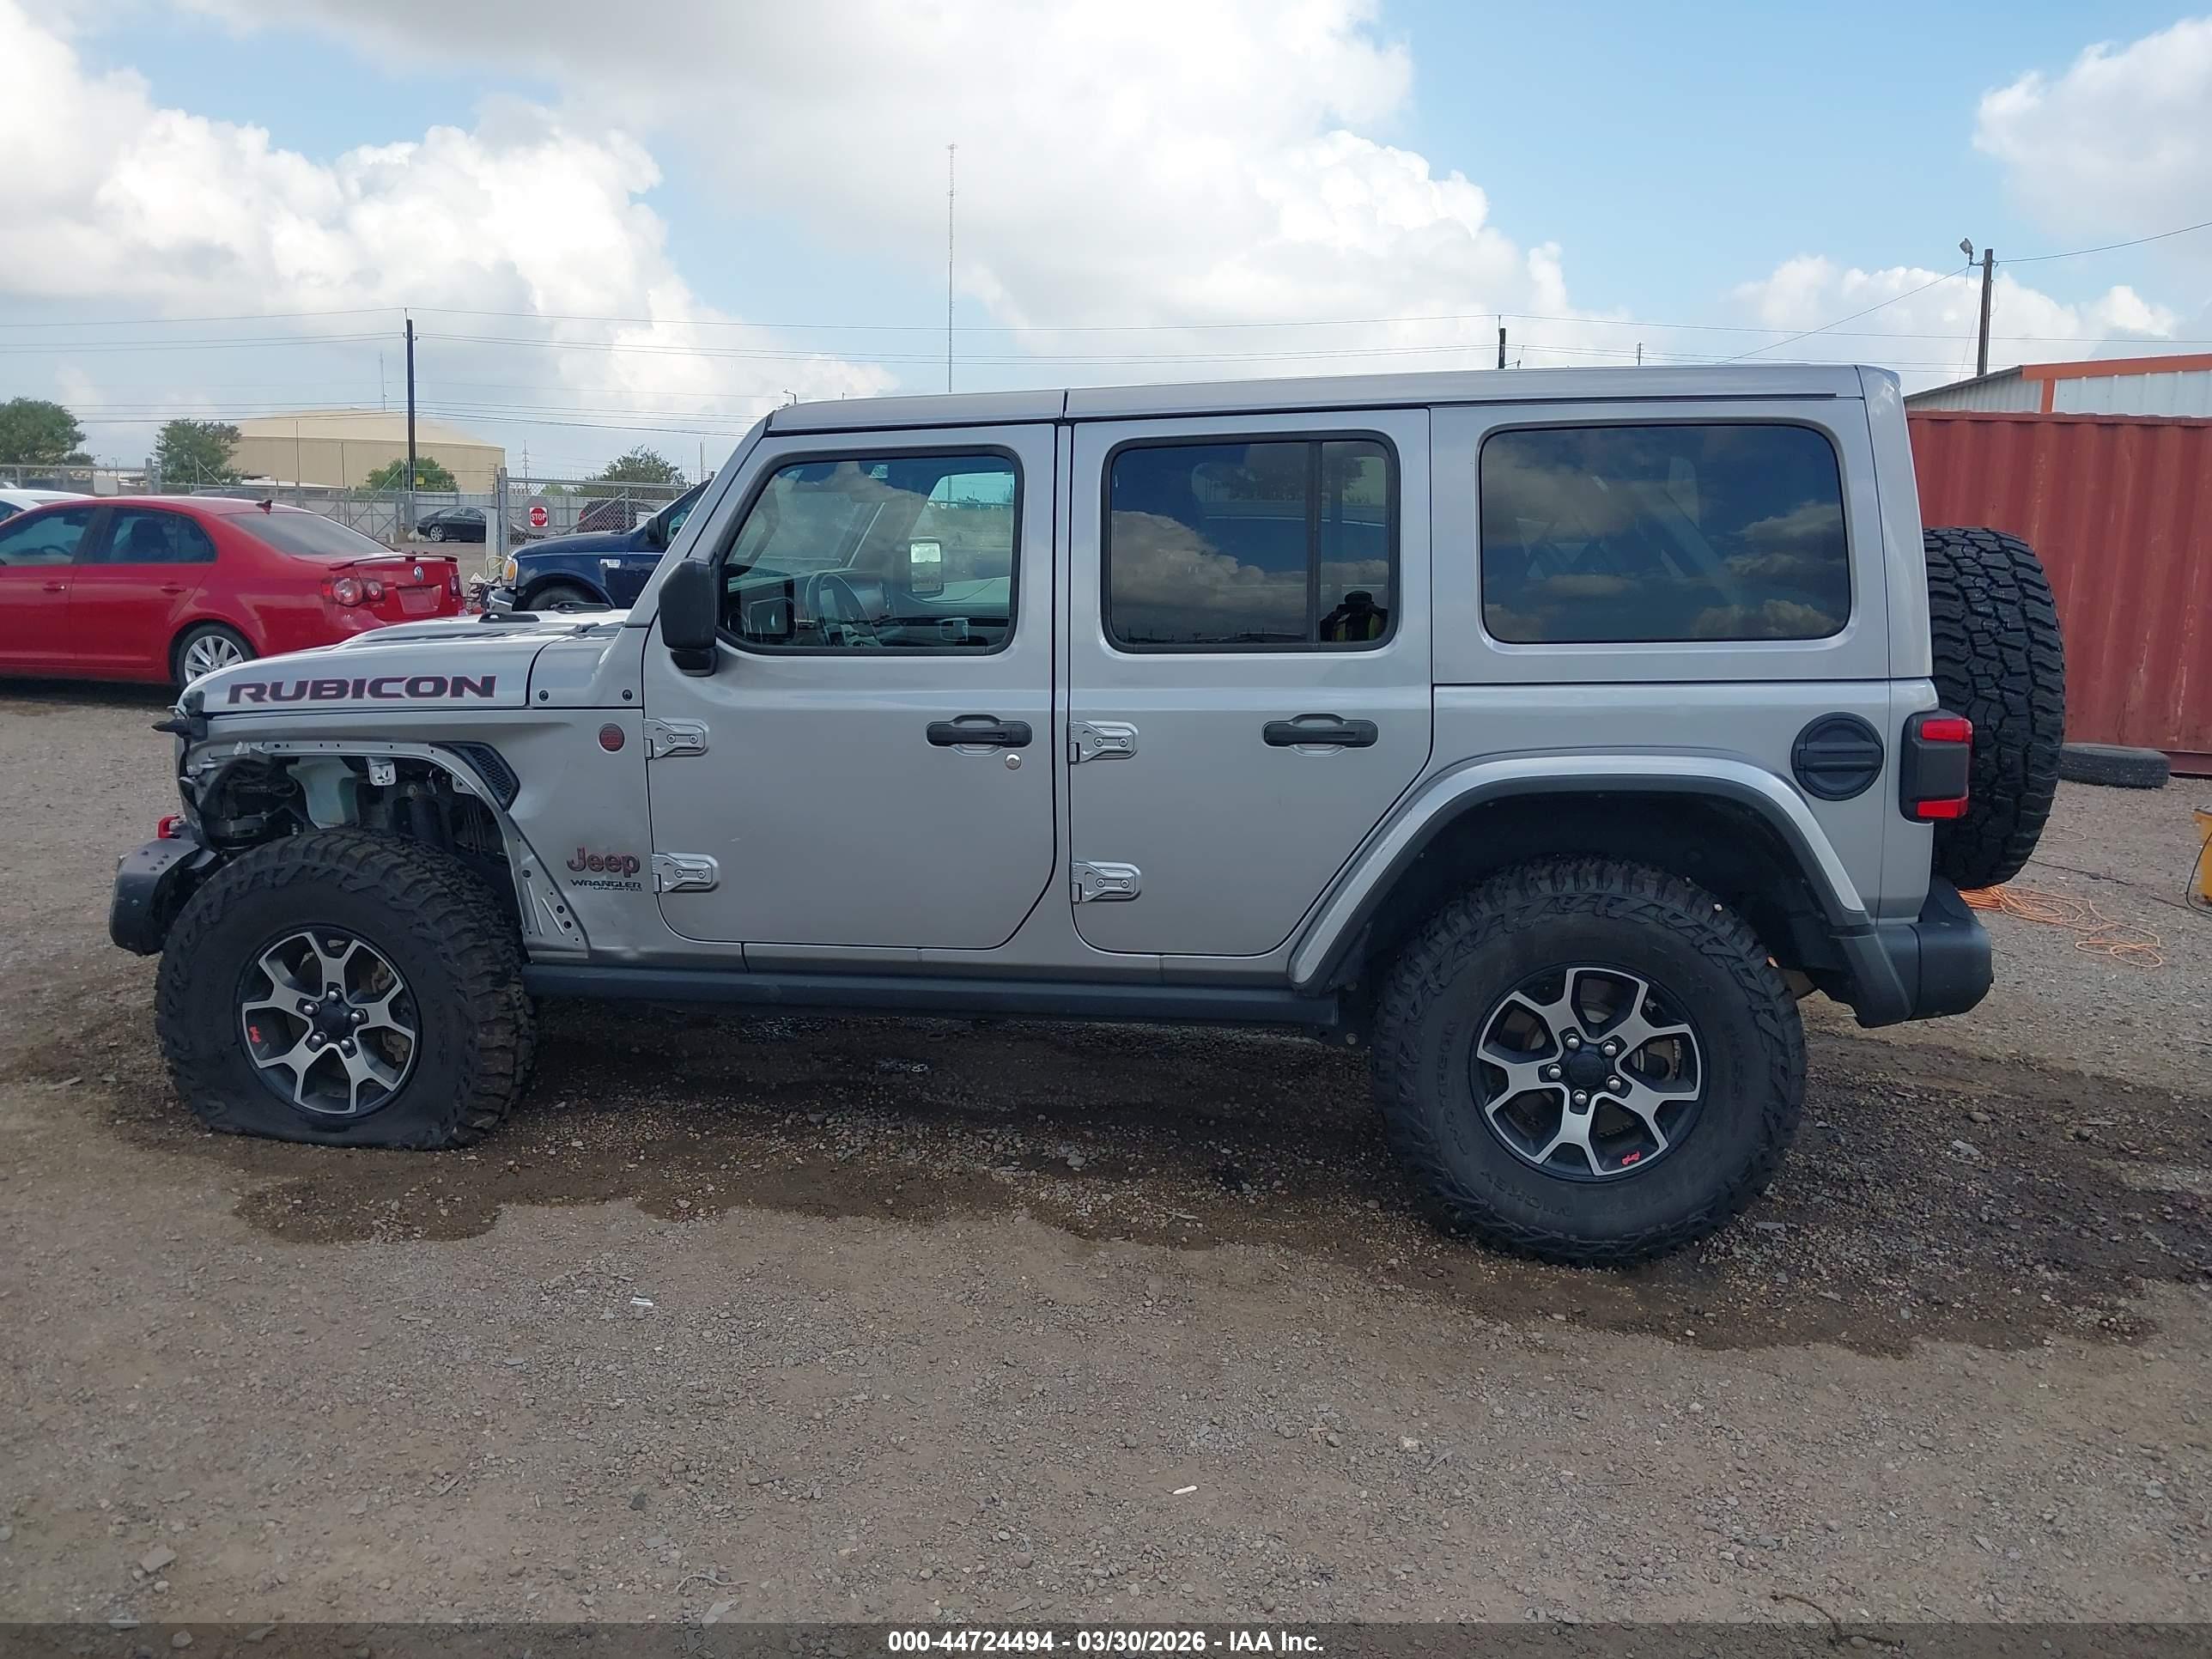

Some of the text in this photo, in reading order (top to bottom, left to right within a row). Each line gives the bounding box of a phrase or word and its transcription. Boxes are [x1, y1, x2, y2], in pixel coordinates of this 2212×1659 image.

[531, 513, 547, 521] STOP
[227, 674, 497, 705] RUBICON
[566, 845, 641, 878] Jeep
[570, 878, 641, 889] WRANGLER
